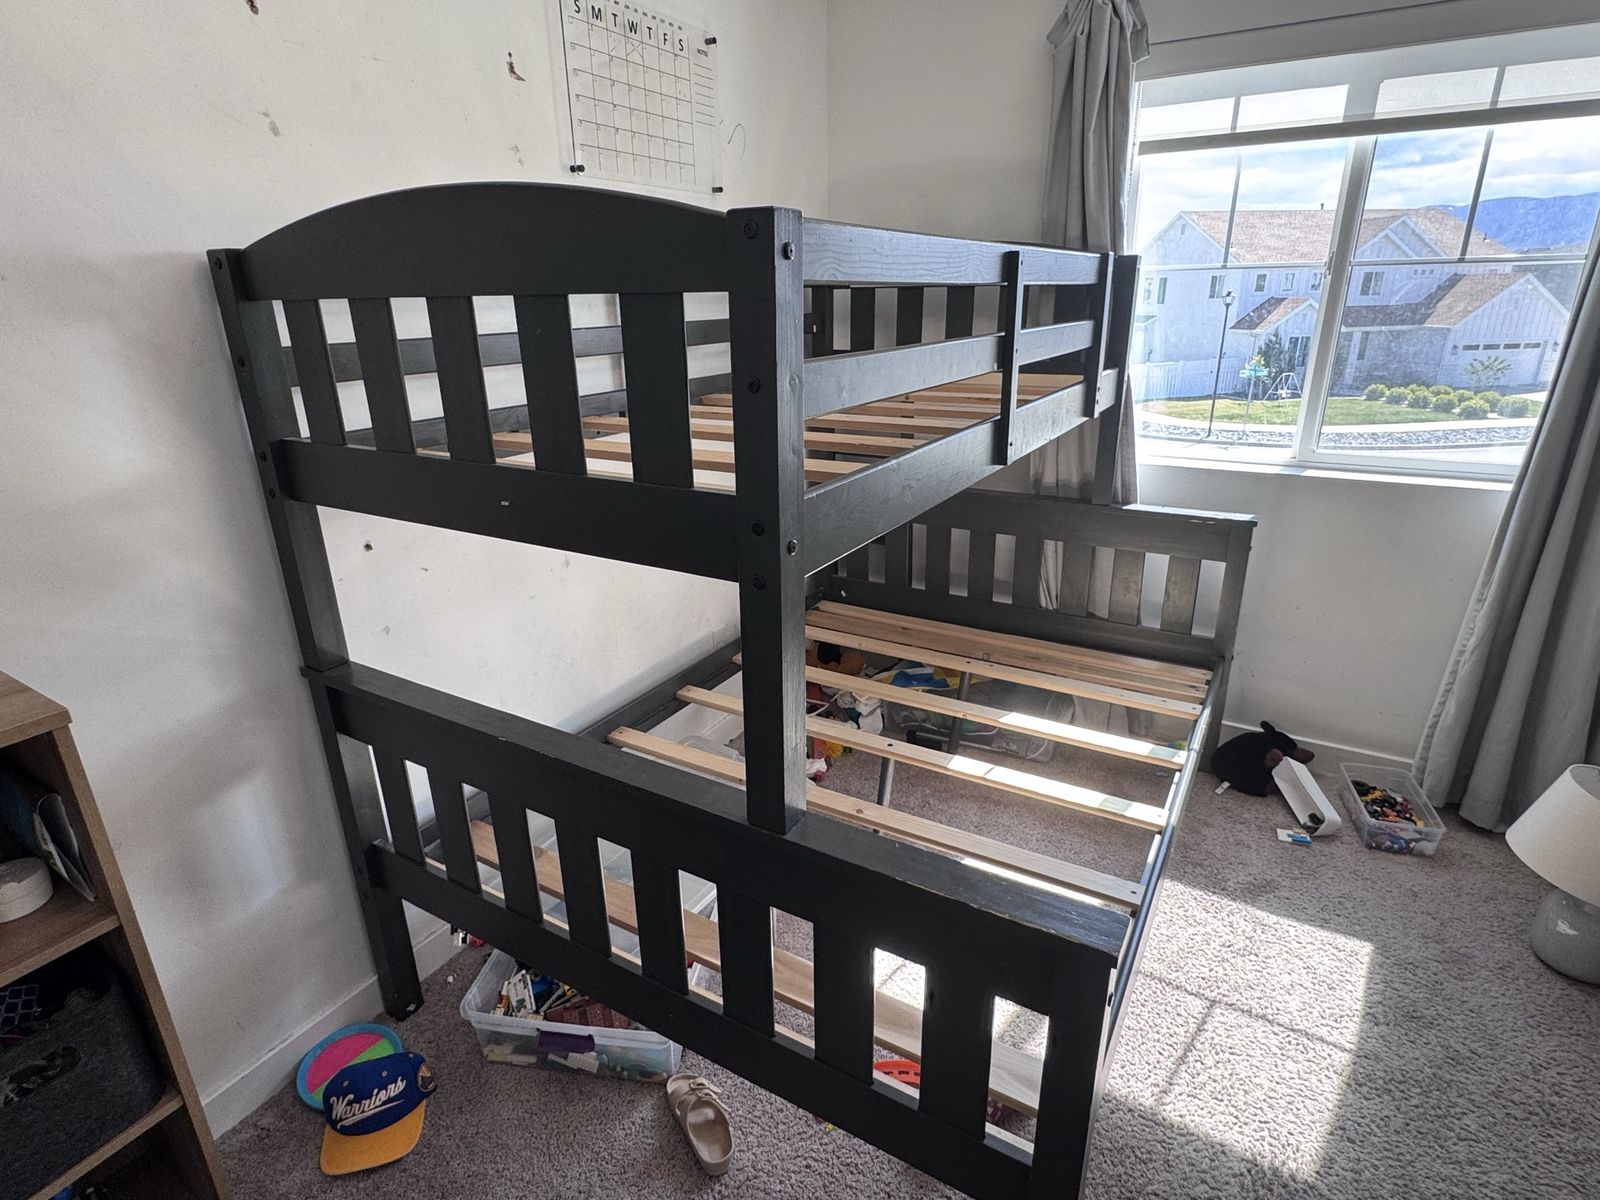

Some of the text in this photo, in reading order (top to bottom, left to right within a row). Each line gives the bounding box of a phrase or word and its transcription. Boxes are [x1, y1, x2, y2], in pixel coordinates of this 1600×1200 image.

[573, 0, 581, 14] S
[591, 4, 602, 22] M
[611, 12, 618, 28] T
[627, 18, 638, 35] W
[646, 26, 653, 40] T
[663, 32, 669, 46] F
[678, 38, 684, 52] S
[329, 1076, 406, 1121] Warriors
